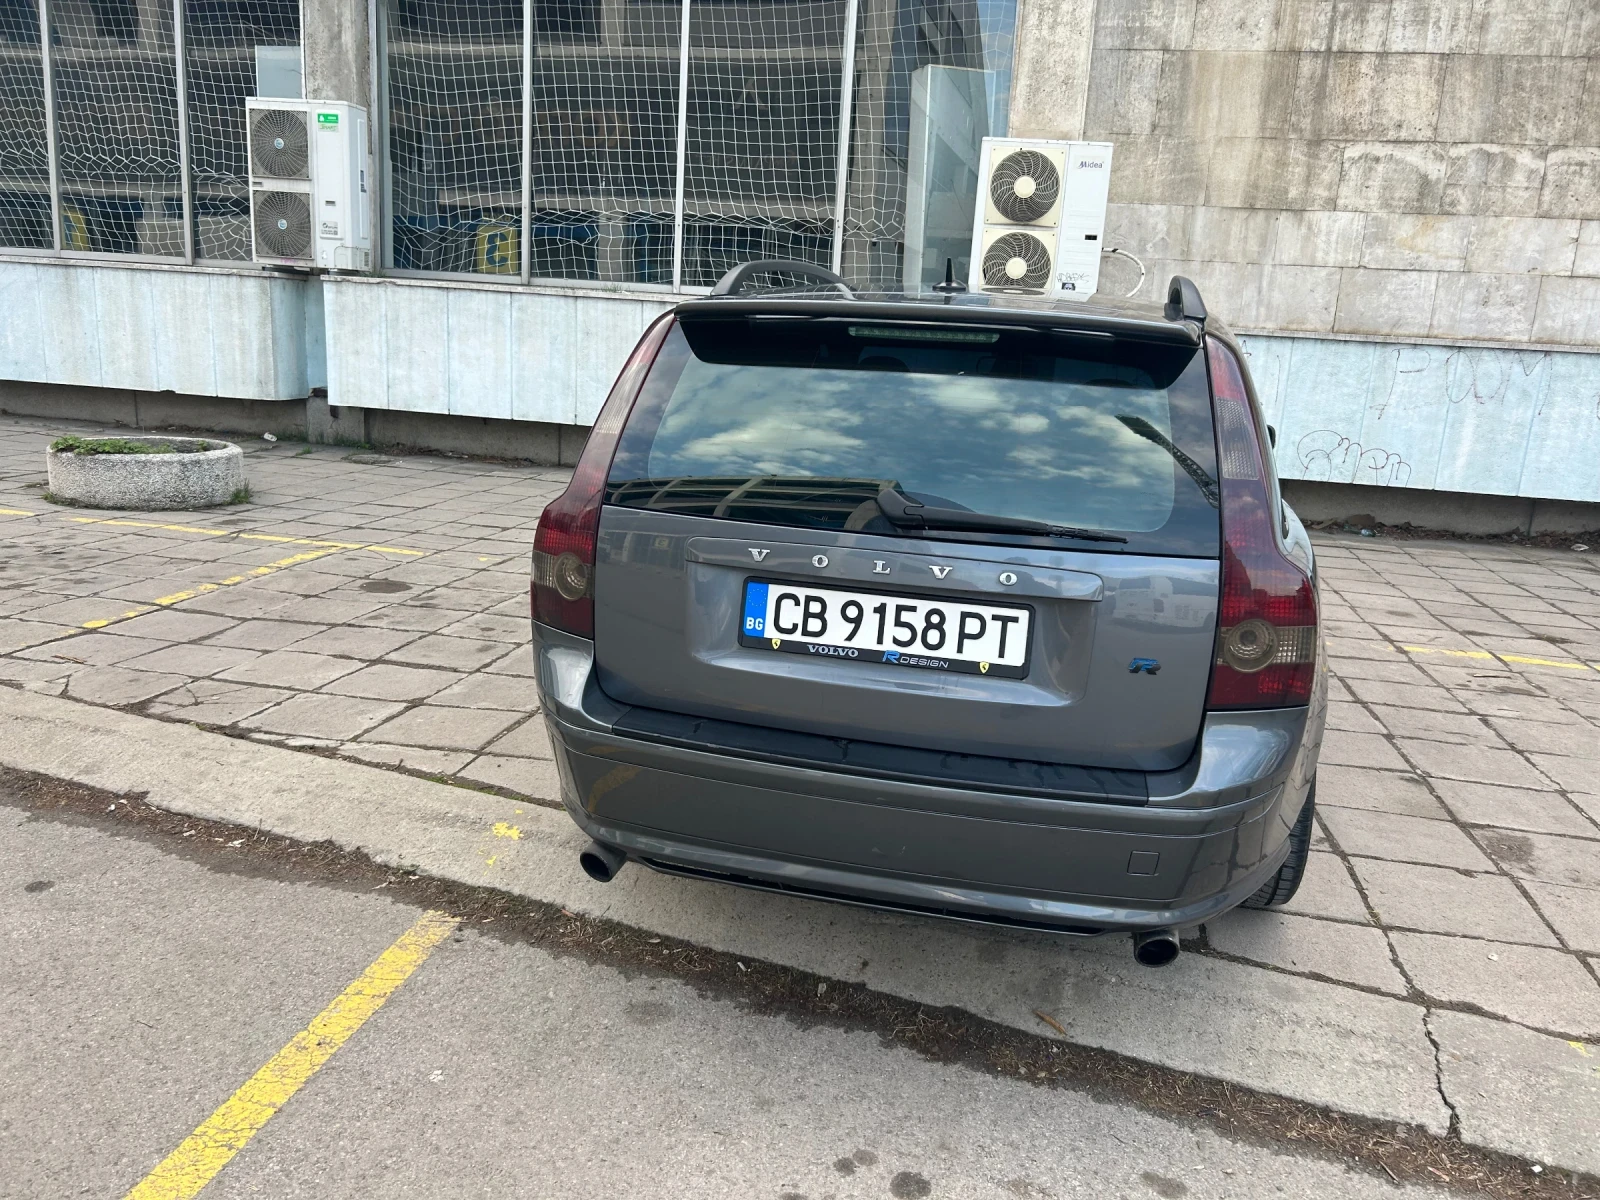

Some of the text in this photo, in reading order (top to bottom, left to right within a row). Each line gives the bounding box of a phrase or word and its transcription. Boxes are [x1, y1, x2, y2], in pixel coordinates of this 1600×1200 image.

[1078, 161, 1102, 169] Midea
[748, 548, 1018, 586] VOLVO
[745, 617, 763, 631] BG
[773, 592, 1019, 659] CB 9158 PT
[806, 644, 859, 658] VOLVO
